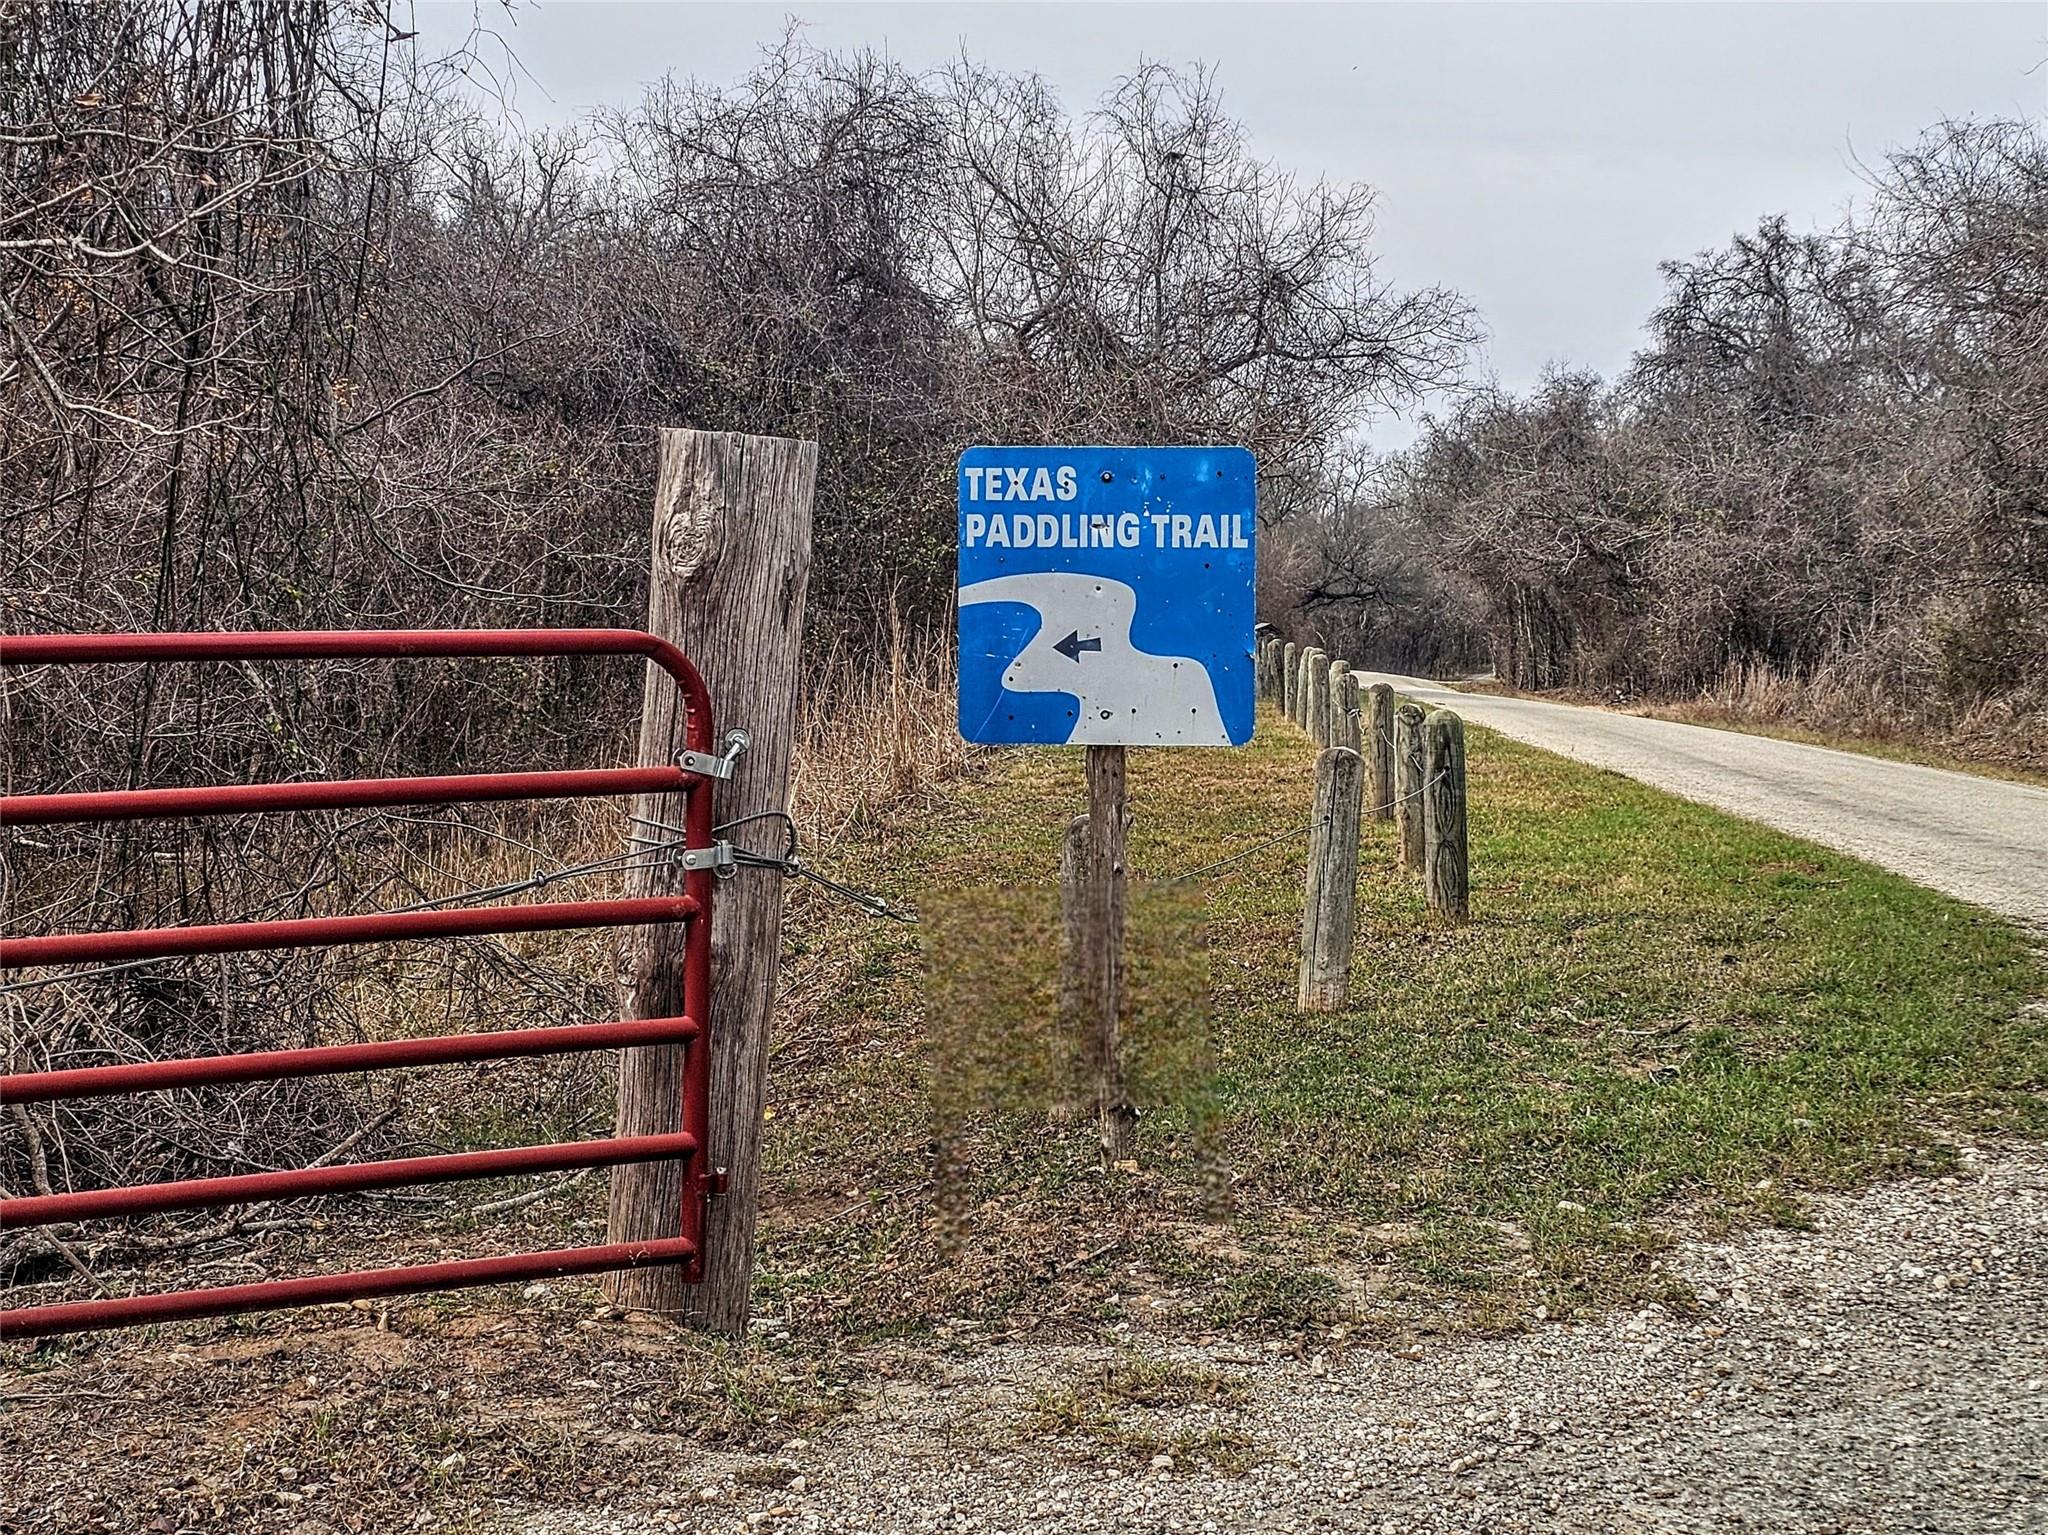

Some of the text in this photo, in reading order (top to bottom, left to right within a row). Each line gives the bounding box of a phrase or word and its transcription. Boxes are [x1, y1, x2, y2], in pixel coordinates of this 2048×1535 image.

[964, 466, 1077, 501] TEXAS
[966, 513, 1249, 548] PADDLING TRAIL
